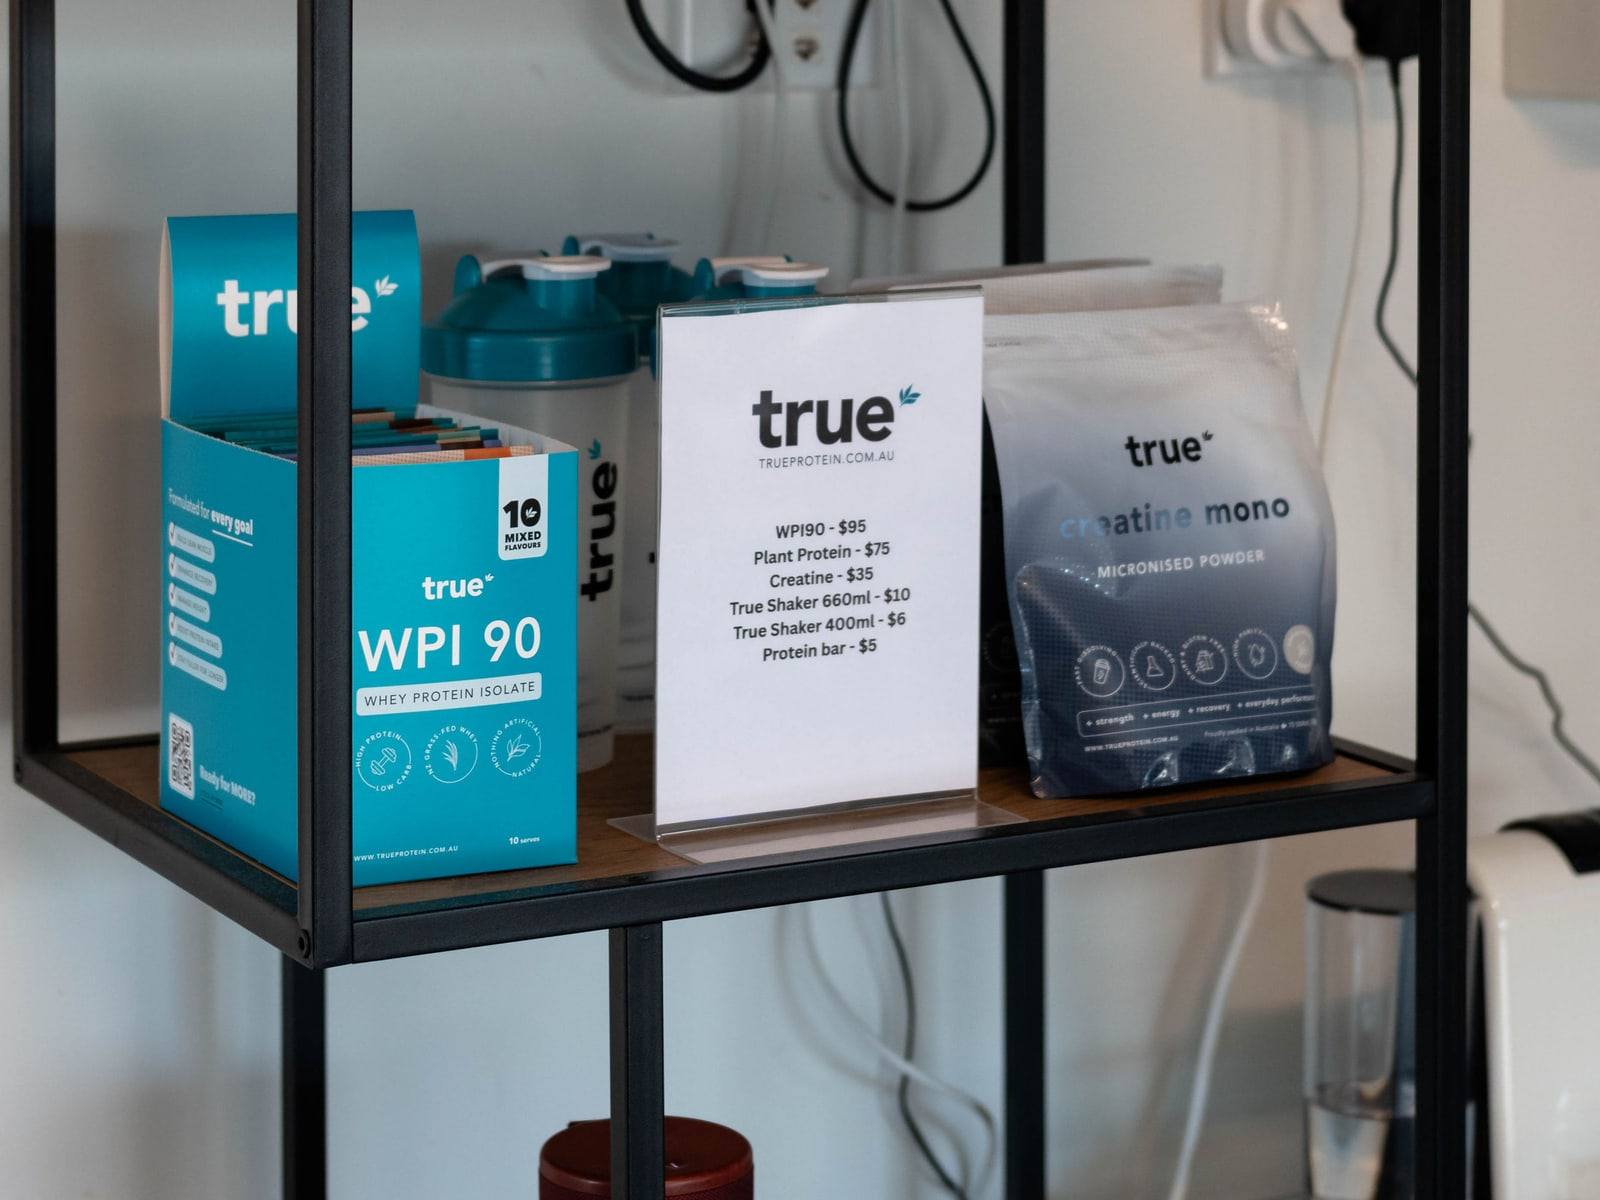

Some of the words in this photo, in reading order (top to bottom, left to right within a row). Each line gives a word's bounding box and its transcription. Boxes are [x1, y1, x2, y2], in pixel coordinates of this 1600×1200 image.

[752, 389, 895, 449] true
[760, 451, 896, 469] TRUEPROTEIN.COM.AU
[1125, 436, 1202, 469] true
[211, 510, 233, 532] every
[234, 519, 253, 536] goal
[502, 498, 542, 529] 10
[1205, 497, 1290, 526] mono
[505, 531, 542, 543] MIXED
[580, 461, 618, 602] true
[775, 522, 825, 540] WPI90
[838, 519, 867, 537] $95
[505, 542, 542, 552] FLAVOURS
[754, 549, 793, 565] Plant
[797, 544, 852, 562] Protein
[865, 542, 891, 558] $75
[1098, 557, 1194, 579] MICRONISED
[1200, 549, 1266, 569] POWDER
[422, 576, 484, 601] true
[770, 569, 834, 588] Creatine
[847, 566, 874, 583] $35
[730, 600, 764, 616] True
[767, 595, 819, 613] Shaker
[822, 590, 871, 608] 660ml
[884, 587, 911, 604] $10
[734, 625, 768, 640] True
[771, 619, 822, 637] Shaker
[825, 614, 875, 632] 400ml
[888, 611, 907, 629] $6
[358, 624, 461, 672] WPI
[484, 616, 542, 663] 90
[763, 644, 818, 662] Protein
[821, 641, 847, 657] bar
[859, 638, 878, 654] $5
[364, 693, 407, 707] WHEY
[413, 687, 474, 705] PROTEIN
[480, 680, 536, 698] ISOLATE
[505, 718, 540, 737] ARTIFICIAL
[1095, 713, 1134, 726] strength
[355, 745, 366, 768] HIGH
[366, 731, 402, 745] PROTEIN
[376, 784, 394, 792] LOW
[353, 844, 459, 862] WWW.TRUEPROTEIN.COM.AU
[509, 836, 519, 845] 10
